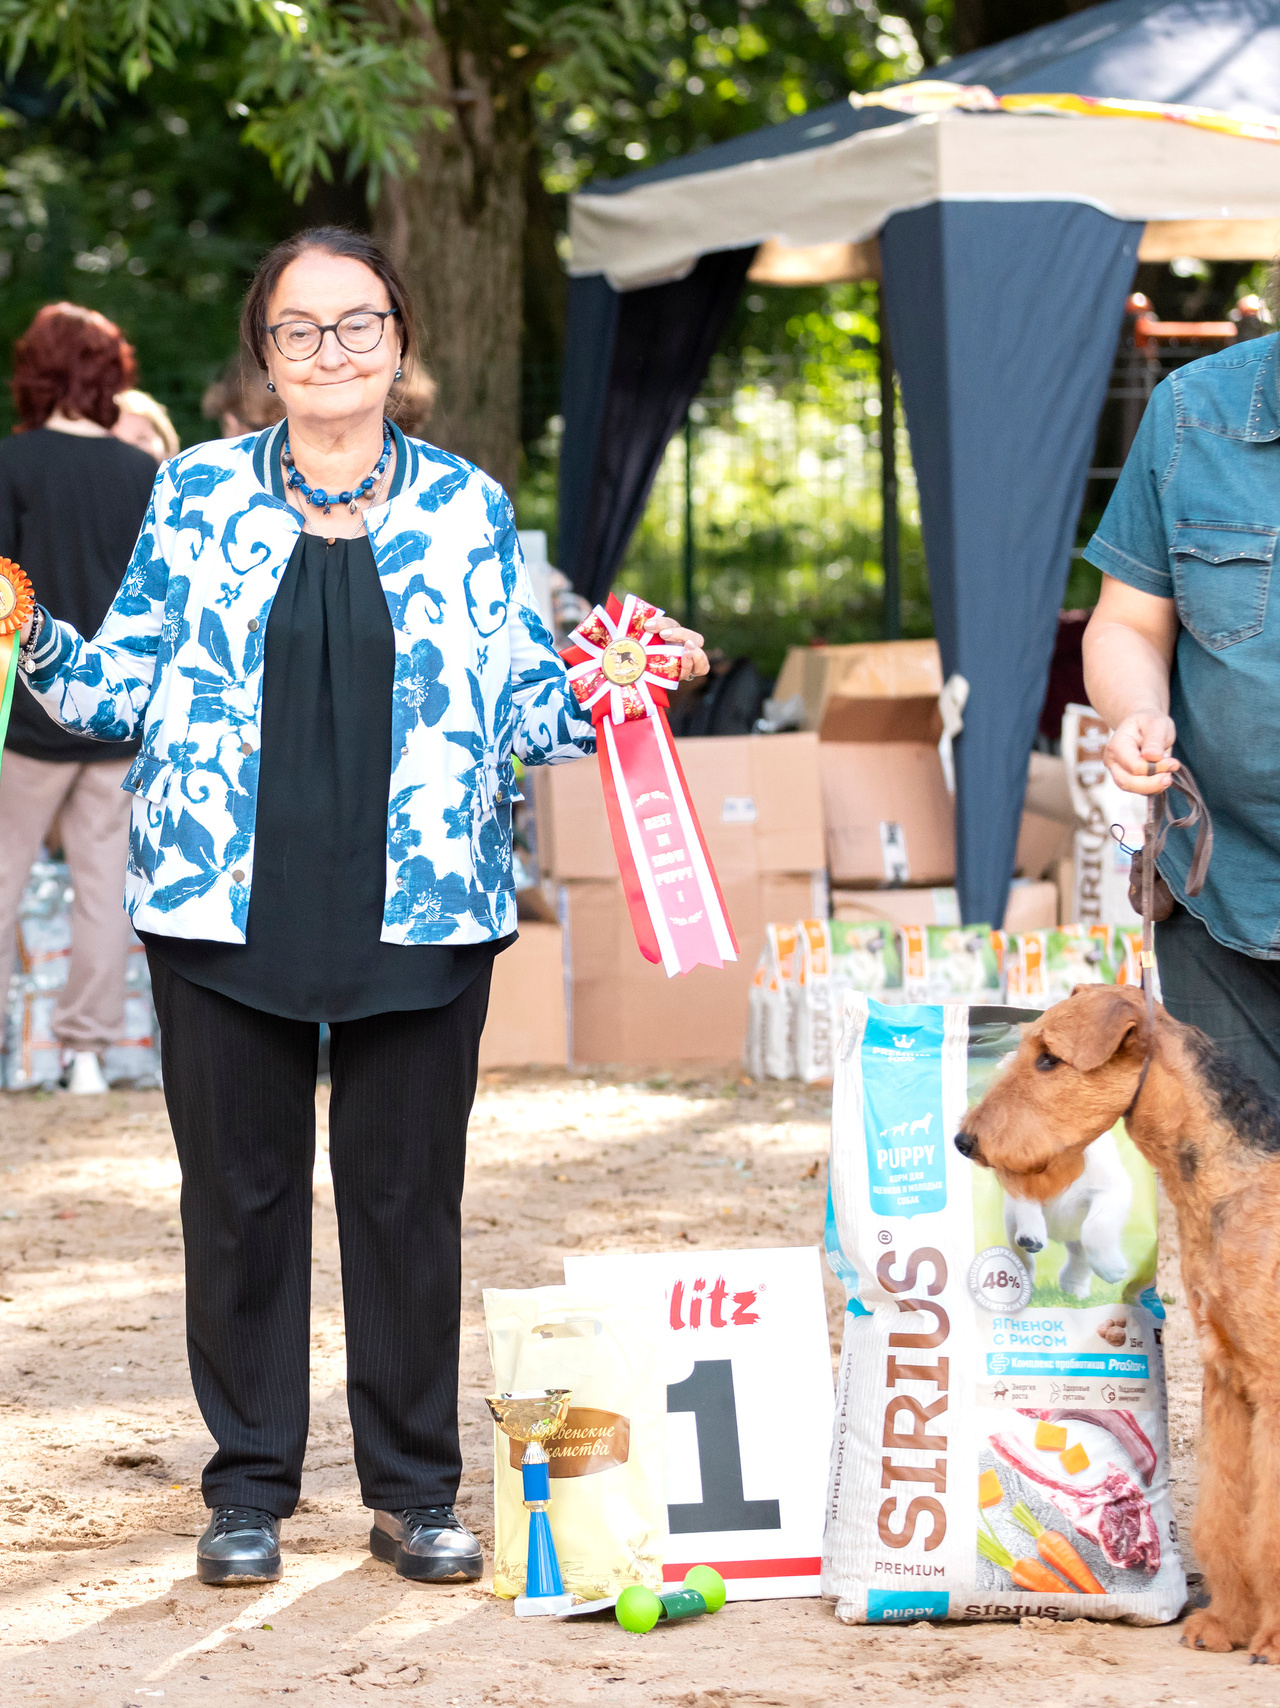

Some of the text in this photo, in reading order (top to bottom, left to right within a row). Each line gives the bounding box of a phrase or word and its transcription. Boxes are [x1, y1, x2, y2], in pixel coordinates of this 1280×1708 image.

[876, 1145, 936, 1170] PUPPY
[897, 1195, 920, 1206] СОБАК
[982, 1270, 1020, 1289] 48%
[666, 1274, 762, 1331] litz
[993, 1317, 1065, 1332] ЯГНЕНОК
[993, 1333, 1067, 1347] С РИСОМ
[1011, 1357, 1054, 1369] Комплекс
[1055, 1358, 1106, 1370] пробиотиков
[1011, 1383, 1036, 1391] Энергия
[877, 1246, 950, 1552] SIRIUS
[552, 1423, 615, 1441] евенские
[545, 1439, 610, 1458] комства
[666, 1359, 781, 1534] 1
[874, 1561, 945, 1577] PREMIUM
[882, 1607, 935, 1619] PUPPY
[963, 1604, 1061, 1618] SIRIUS
